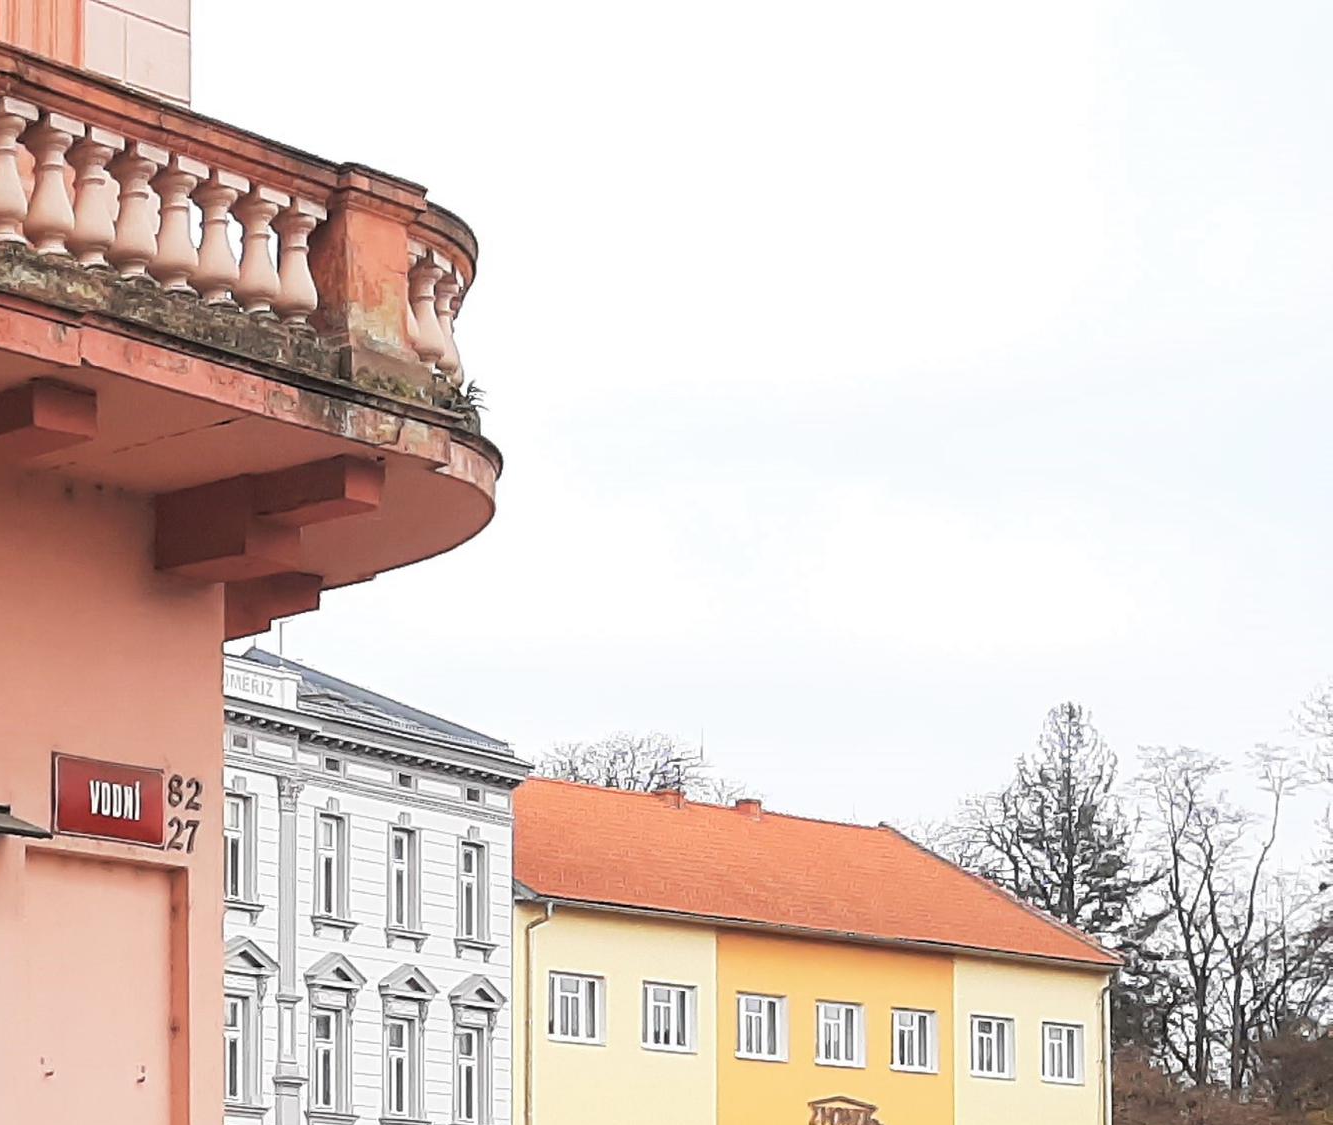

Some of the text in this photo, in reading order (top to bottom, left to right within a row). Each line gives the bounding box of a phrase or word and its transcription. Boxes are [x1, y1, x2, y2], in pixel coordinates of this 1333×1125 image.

[89, 779, 142, 821] VODNÍ
[167, 774, 203, 811] 82
[167, 817, 201, 853] 27
